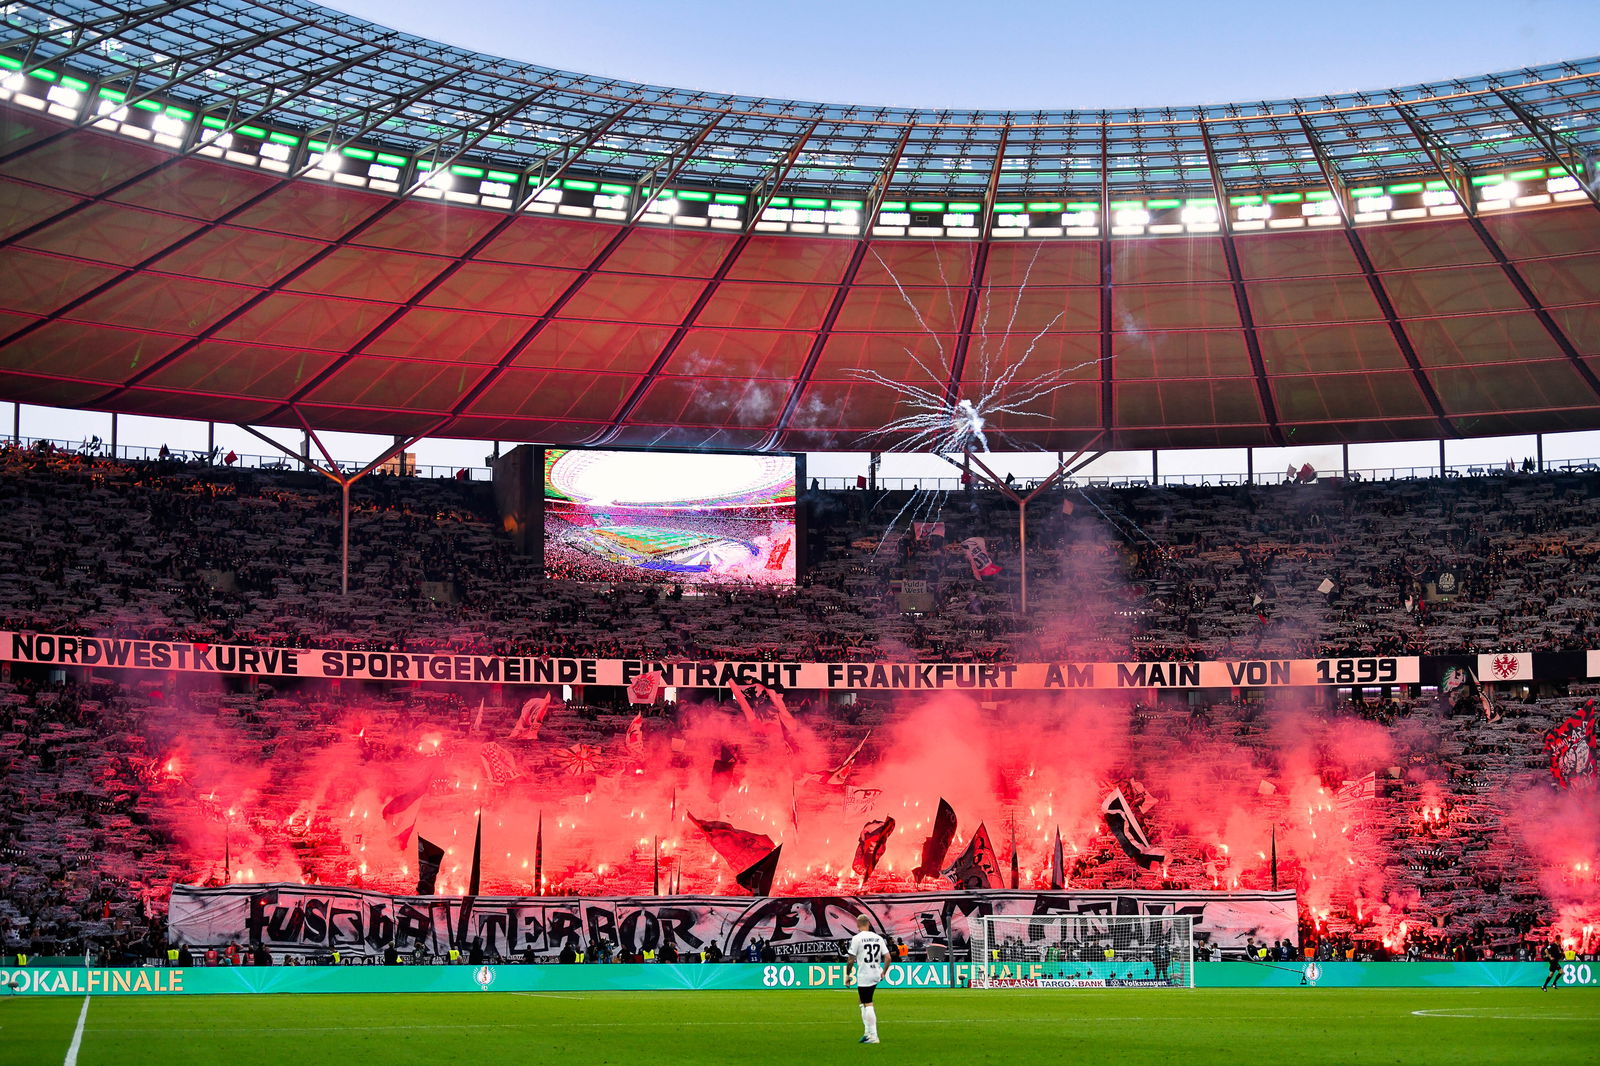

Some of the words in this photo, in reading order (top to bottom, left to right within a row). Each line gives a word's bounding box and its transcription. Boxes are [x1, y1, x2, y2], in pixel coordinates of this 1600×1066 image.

[11, 634, 298, 674] NORDWESTKURVE
[322, 652, 597, 683] SPORTGEMEINDE
[827, 664, 1018, 688] FRANKFURT
[1044, 664, 1094, 688] AM
[1117, 663, 1200, 687] MAIN
[1226, 661, 1291, 685] VON
[1316, 659, 1398, 684] 1899
[864, 944, 880, 963] 32
[762, 965, 801, 987] 80.
[1562, 963, 1598, 985] 80.
